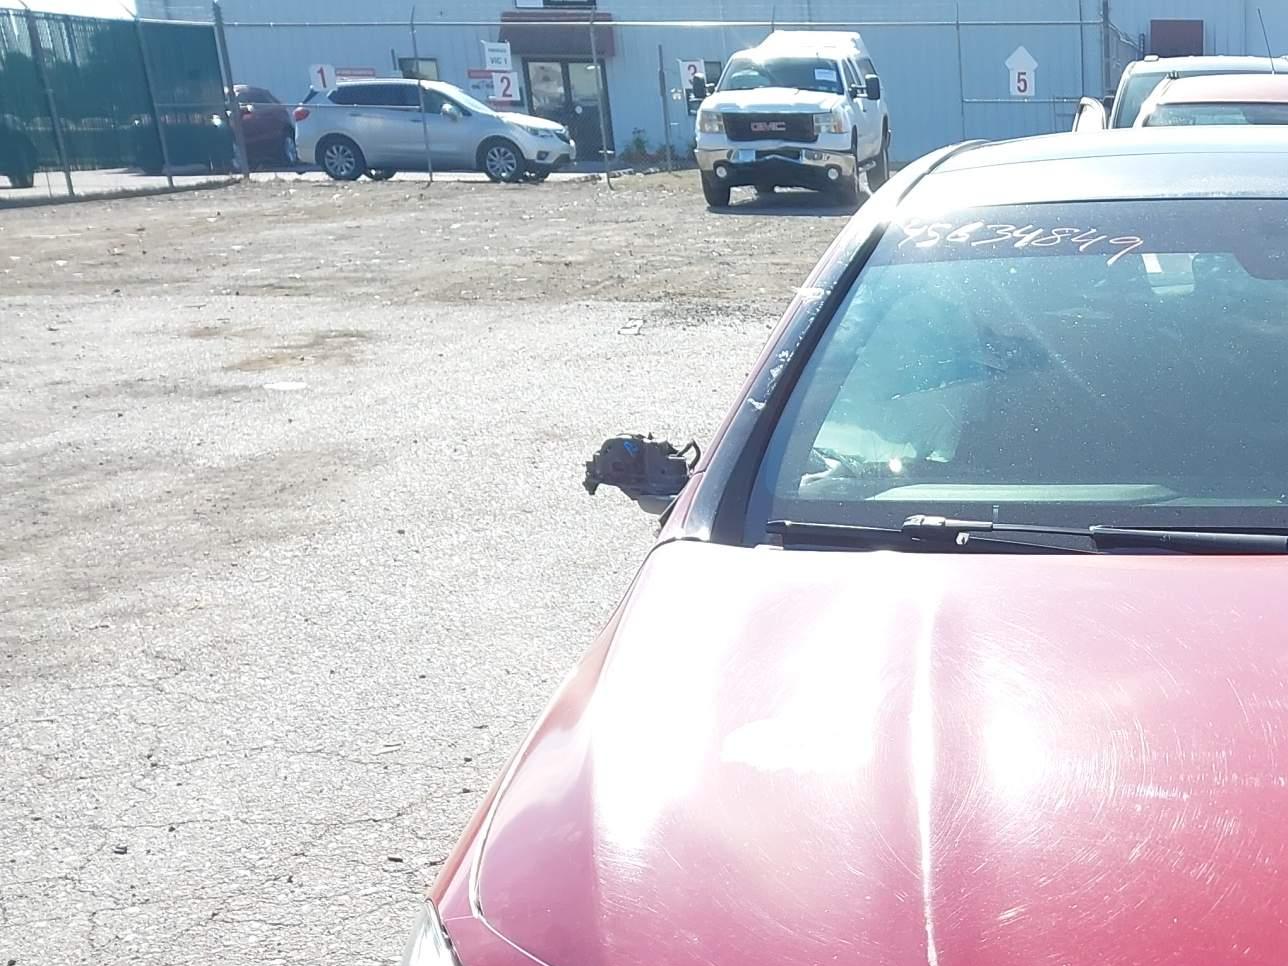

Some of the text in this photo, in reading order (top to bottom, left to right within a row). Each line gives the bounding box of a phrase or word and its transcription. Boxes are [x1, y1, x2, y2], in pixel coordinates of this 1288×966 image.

[317, 67, 326, 88] 1
[500, 76, 512, 97] 2
[1017, 71, 1027, 93] 5
[751, 122, 785, 132] GMC
